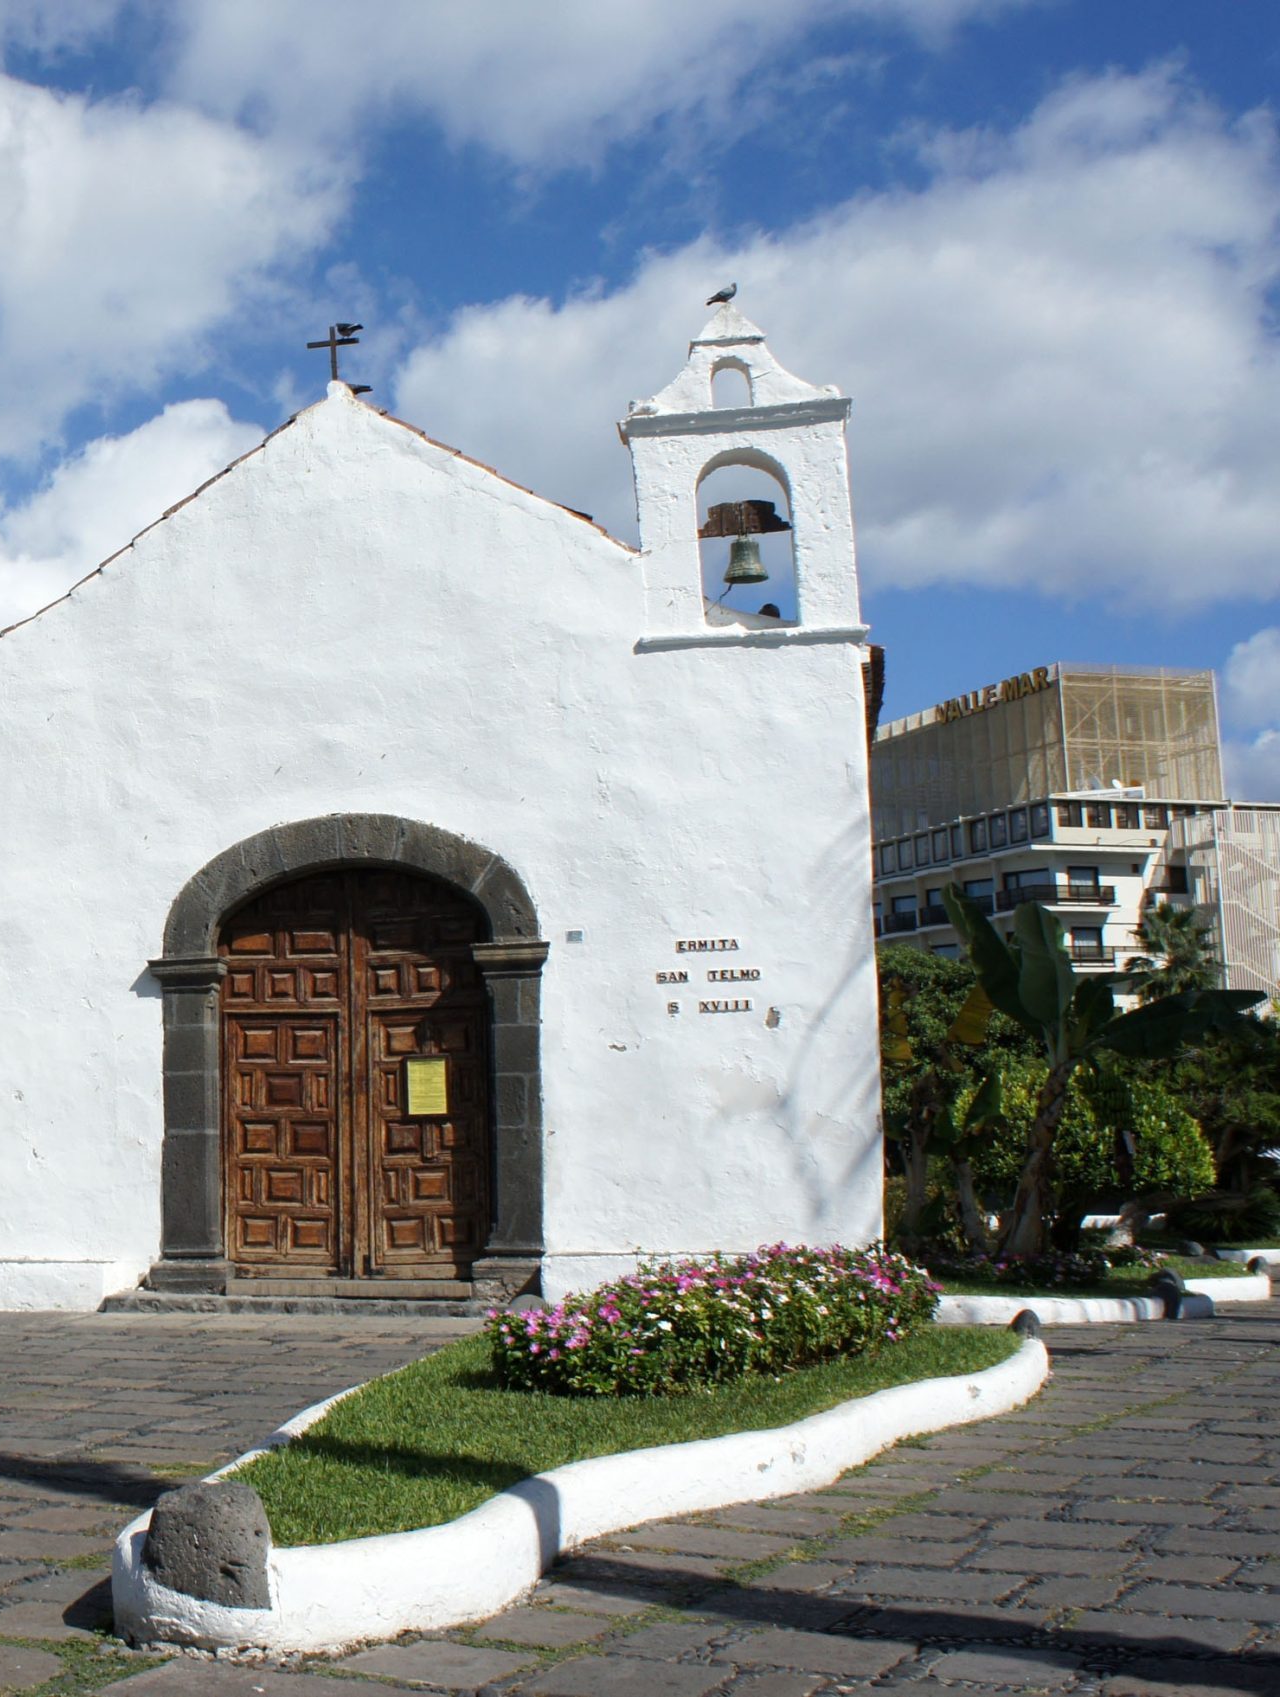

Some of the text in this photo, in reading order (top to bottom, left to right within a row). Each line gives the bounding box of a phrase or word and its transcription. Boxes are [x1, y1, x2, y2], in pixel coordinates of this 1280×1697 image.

[676, 939, 739, 953] ERMITA
[656, 969, 761, 984] SAN TELMO
[699, 1000, 752, 1013] XVIII
